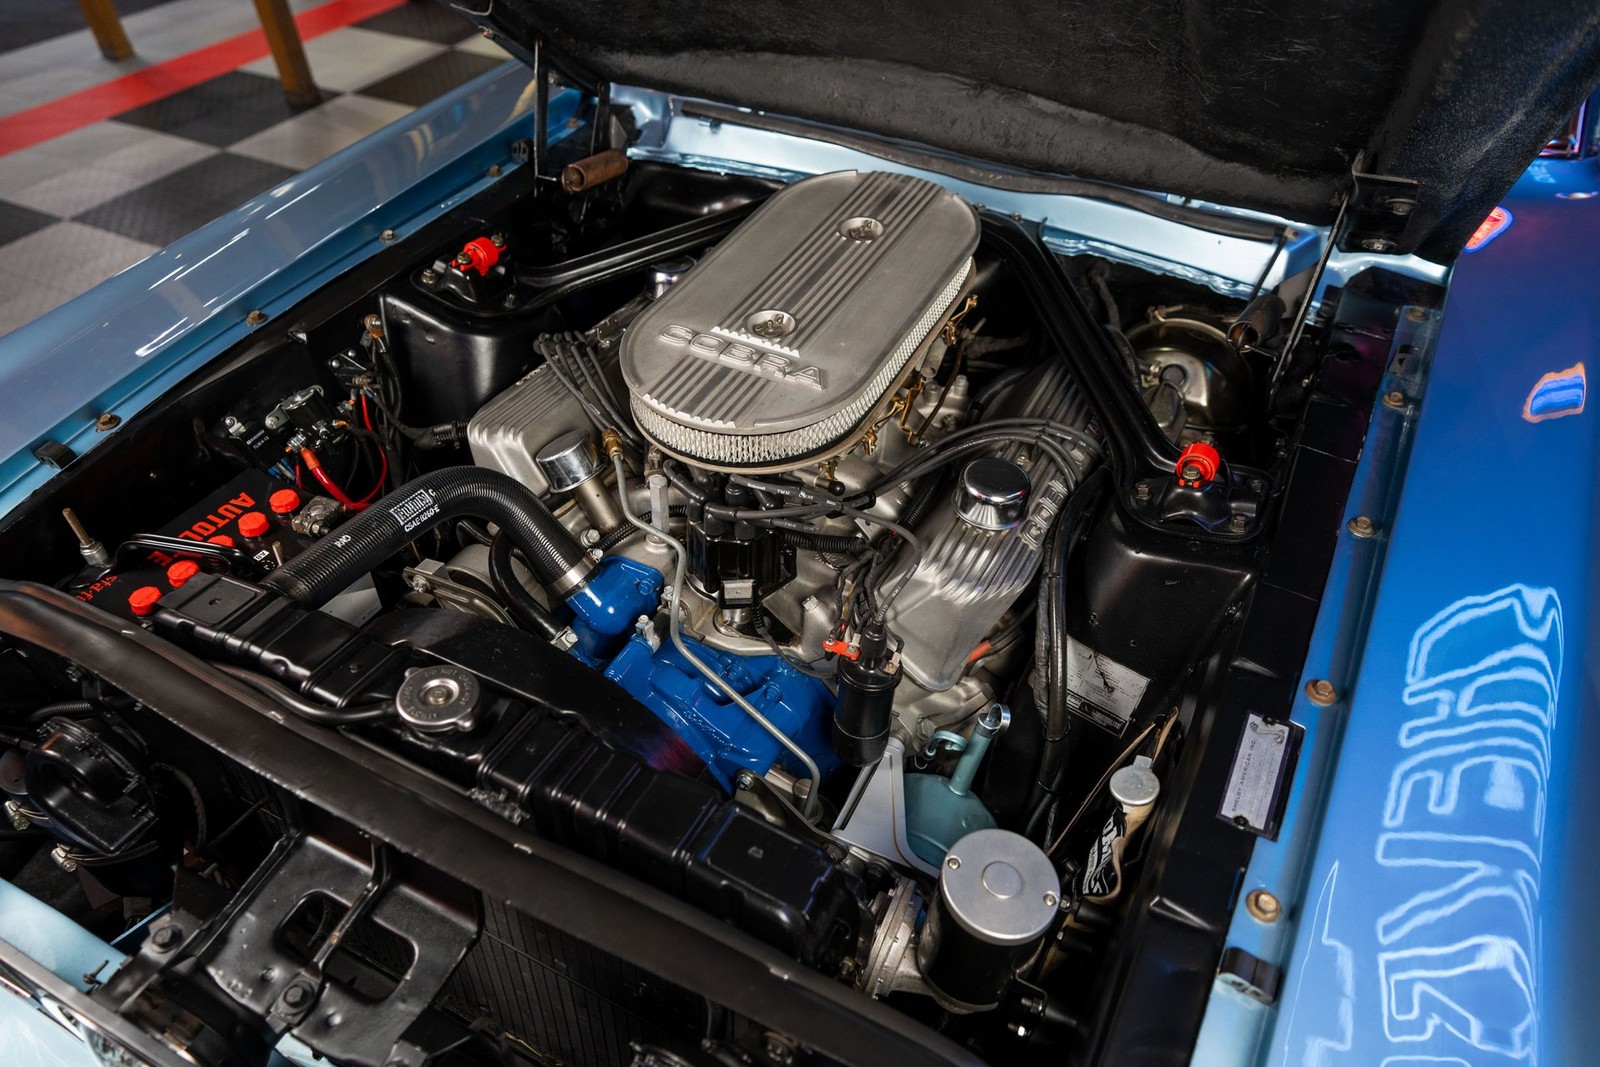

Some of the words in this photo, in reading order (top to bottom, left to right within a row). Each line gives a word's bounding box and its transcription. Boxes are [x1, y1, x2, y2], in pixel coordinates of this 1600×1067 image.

[658, 324, 826, 390] COBRA
[147, 491, 256, 567] AUTOLE
[334, 534, 351, 548] RAD
[424, 669, 438, 677] DO
[440, 668, 458, 676] NOT
[1231, 787, 1242, 812] SHELBY
[1240, 752, 1252, 786] AMERICAN
